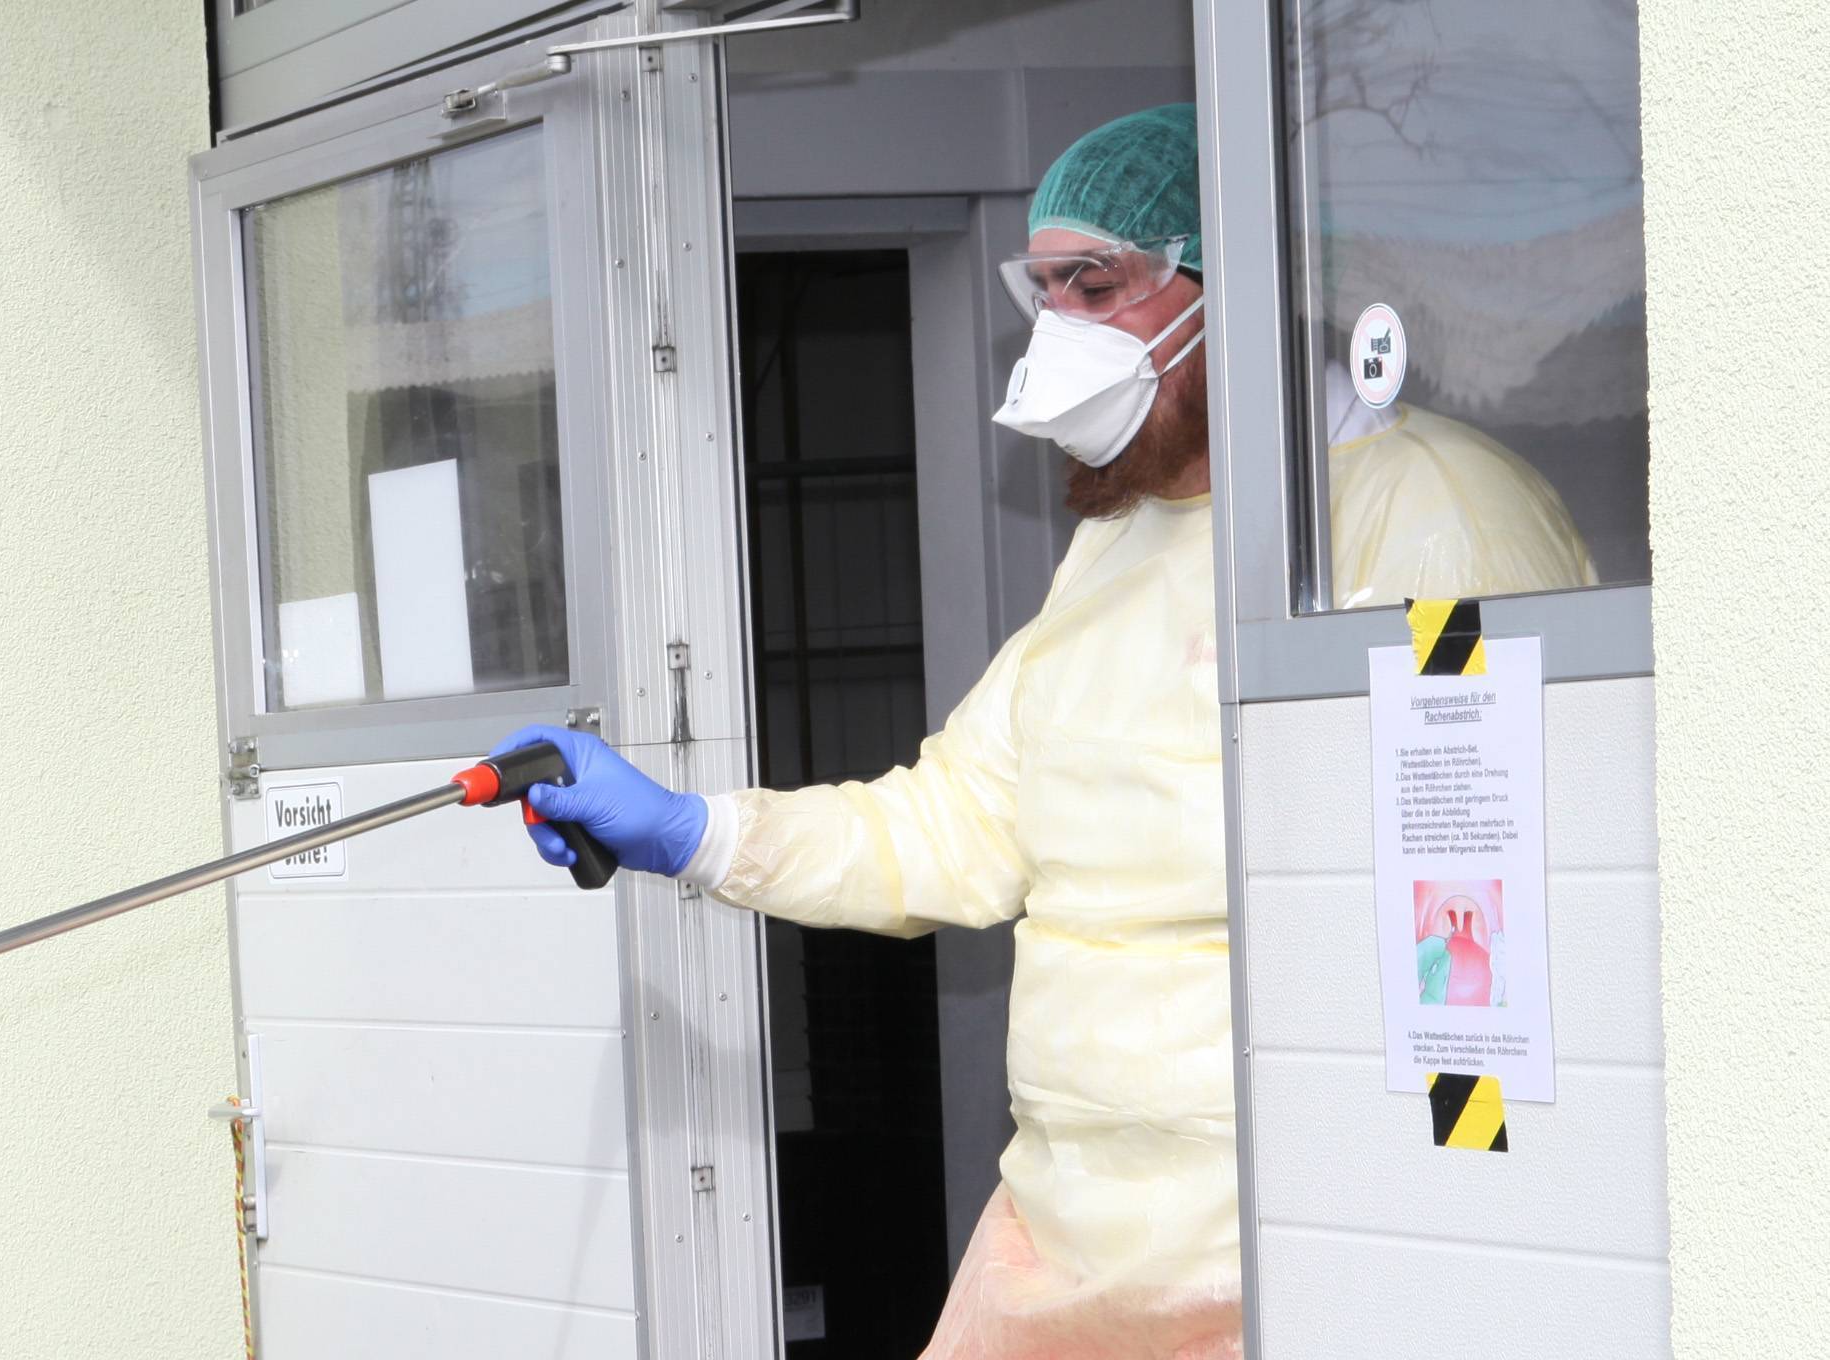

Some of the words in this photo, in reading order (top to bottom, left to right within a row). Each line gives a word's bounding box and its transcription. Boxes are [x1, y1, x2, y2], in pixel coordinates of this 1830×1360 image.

[1410, 695, 1468, 708] Vorgehensweise
[1470, 692, 1481, 703] für
[1482, 691, 1496, 702] den
[1424, 709, 1482, 722] Rachenabstrich:
[275, 795, 331, 827] Vorsicht
